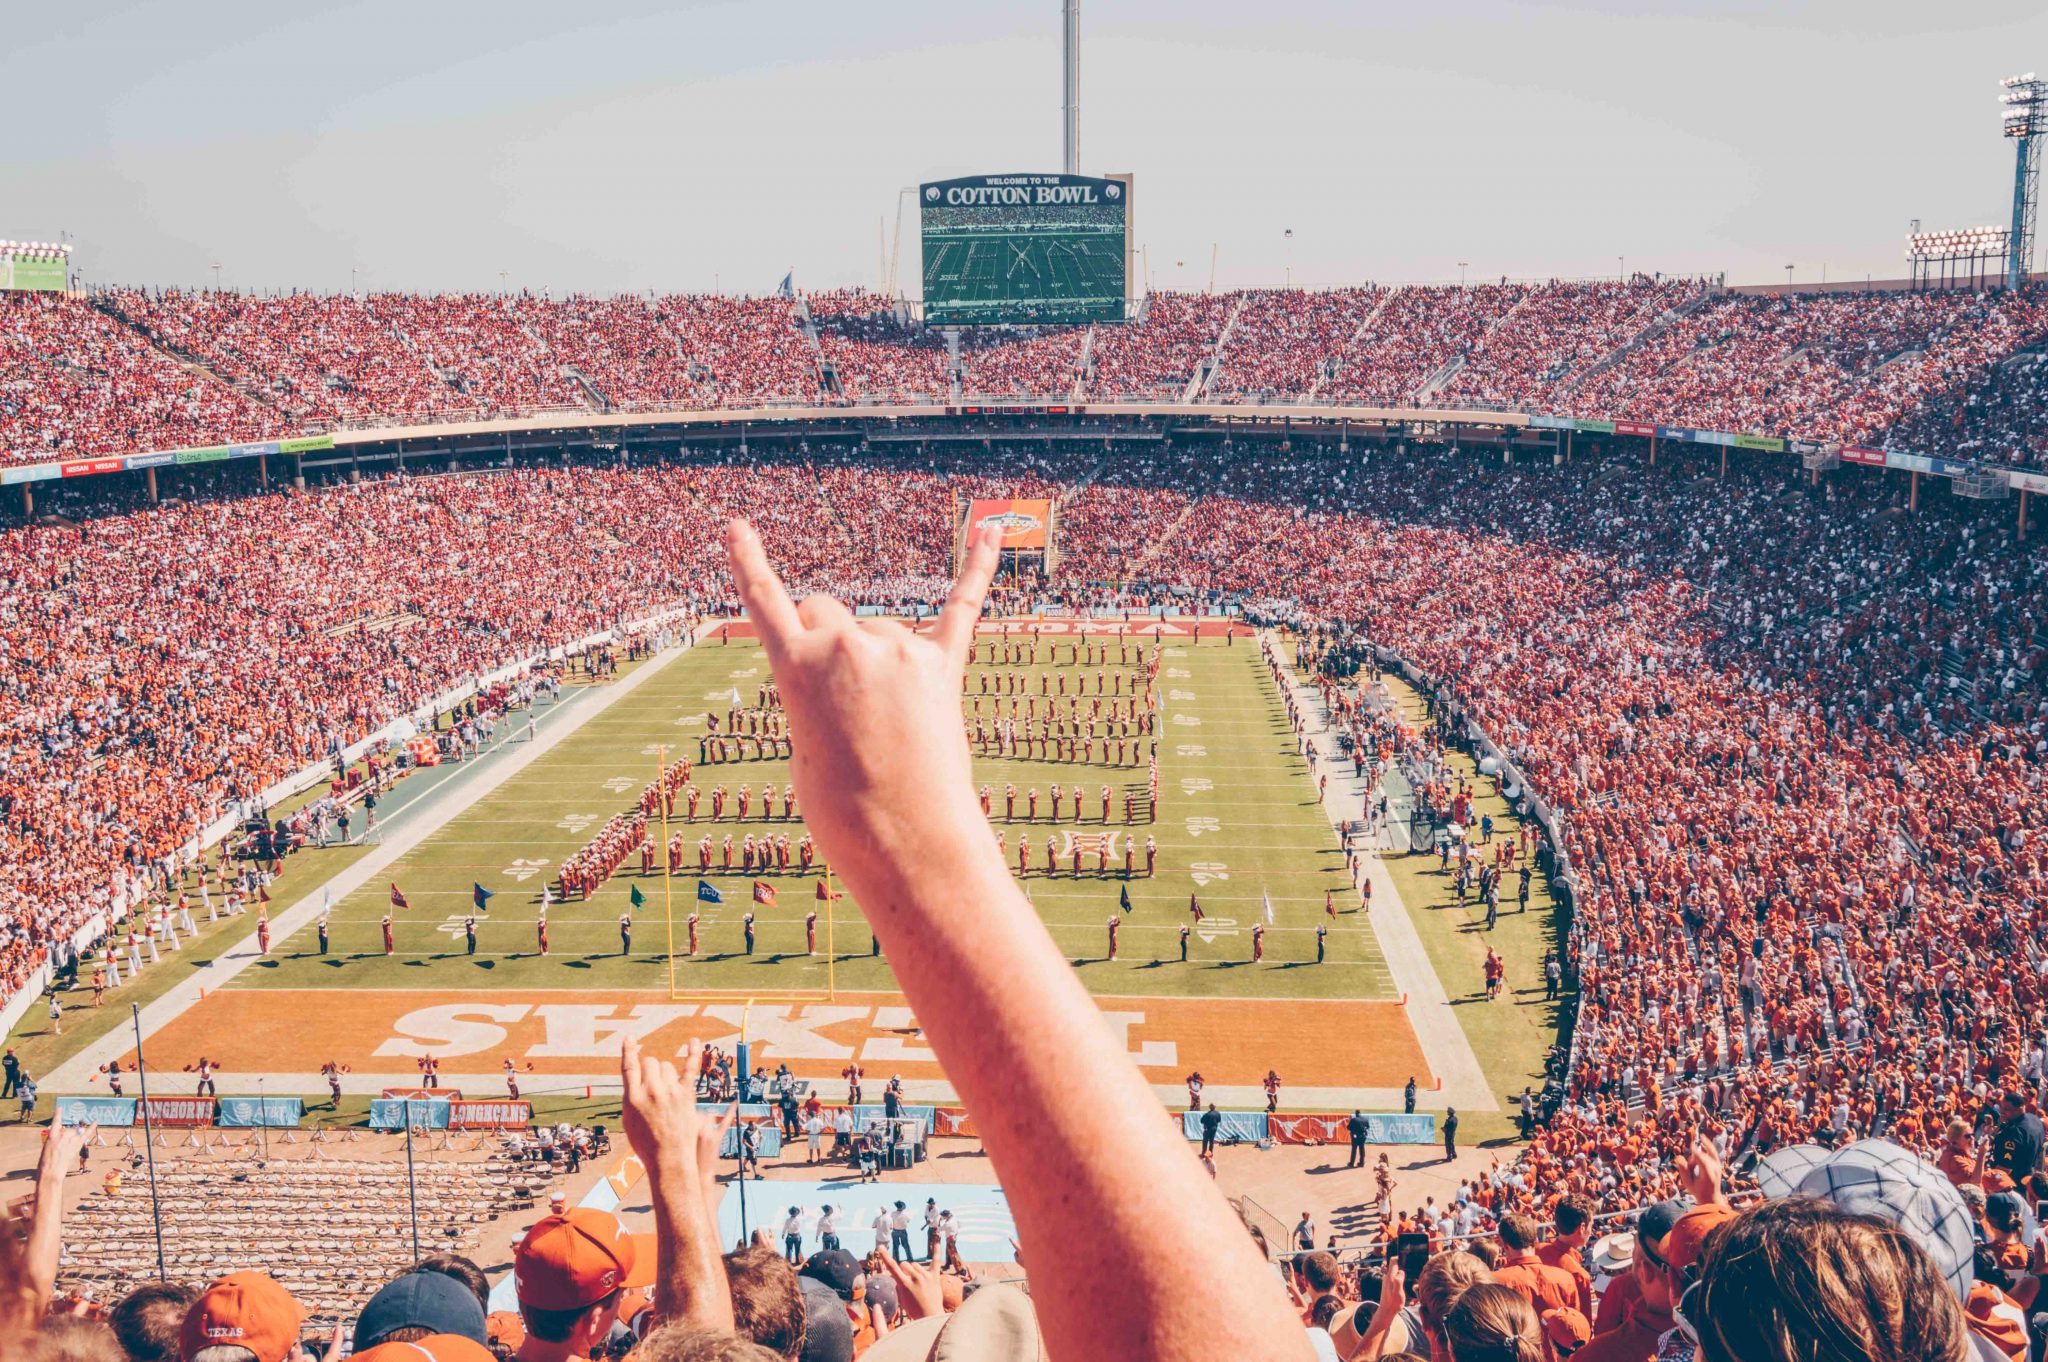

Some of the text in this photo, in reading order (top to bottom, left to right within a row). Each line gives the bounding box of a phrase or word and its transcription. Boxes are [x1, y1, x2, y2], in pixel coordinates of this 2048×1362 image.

[986, 177, 1028, 185] WELCOME
[946, 186, 1098, 205] COTTON BOWL
[1842, 450, 1883, 461] NISSAN NISSAN
[66, 462, 118, 474] NISSAN NISSAN
[976, 622, 1189, 634] HOMA
[1185, 816, 1221, 832] 30
[502, 858, 550, 876] 20
[1189, 862, 1230, 881] 20
[701, 887, 717, 897] TCU
[1196, 917, 1240, 936] 10
[90, 1105, 122, 1121] AT&T
[136, 1101, 212, 1120] LONGHORNS
[255, 1105, 288, 1119] AT&T
[1388, 1122, 1421, 1136] AT&T
[208, 1327, 243, 1338] TEXAS
